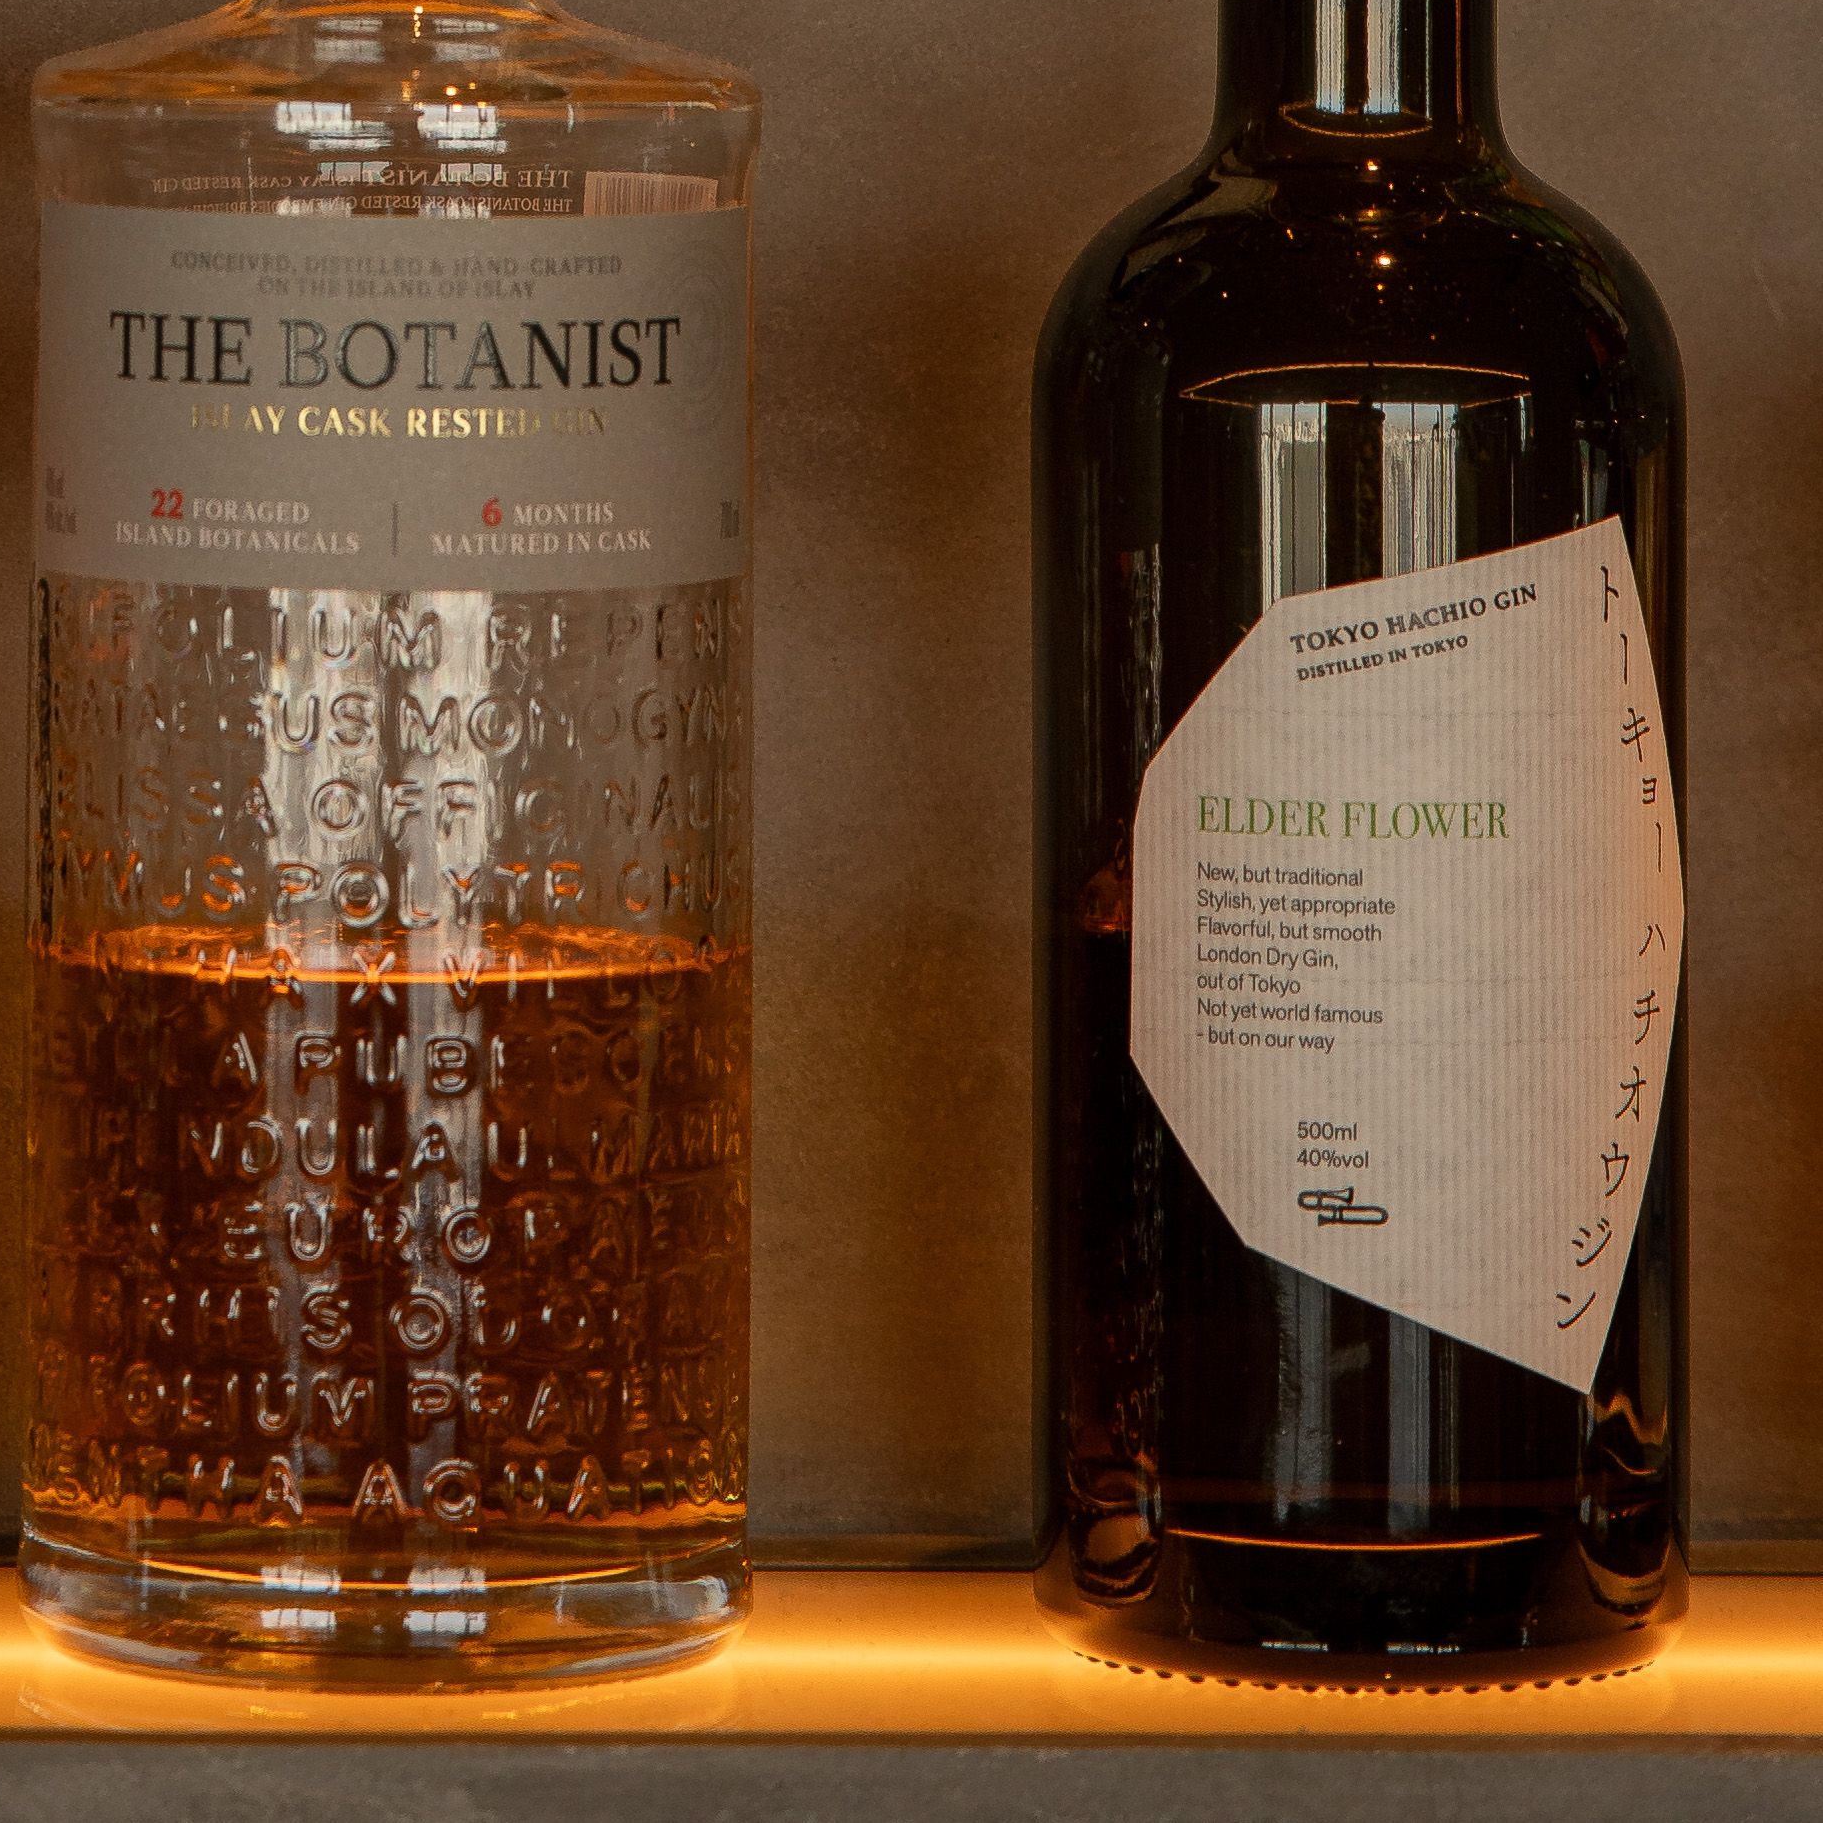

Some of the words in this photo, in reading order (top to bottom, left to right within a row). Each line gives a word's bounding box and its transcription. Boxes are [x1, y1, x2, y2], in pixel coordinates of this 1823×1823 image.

[109, 310, 253, 387] THE
[278, 317, 680, 392] BOTANIST
[297, 407, 393, 438] CASK
[407, 407, 541, 439] RESTED
[151, 489, 184, 519] 22
[193, 498, 311, 524] FORAGED
[482, 497, 503, 527] 6
[512, 503, 614, 525] MONTHS
[114, 521, 192, 548] ISLAND
[198, 527, 361, 555] BOTANICALS
[429, 533, 559, 555] MATURED
[567, 531, 592, 554] IN
[598, 529, 652, 552] CASK
[1290, 622, 1379, 654] TOKYO
[1386, 597, 1486, 636] HACHIO
[1493, 583, 1537, 611] GIN
[1296, 653, 1384, 682] DISTILLED
[1389, 647, 1407, 664] IN
[1411, 635, 1468, 659] TOKYO
[1198, 796, 1330, 837] ELDER
[1342, 802, 1509, 839] FLOWER
[1197, 862, 1239, 883] New,
[1243, 864, 1271, 884] but
[1276, 868, 1363, 886] traditional
[1197, 889, 1256, 912] Stylish,
[1259, 895, 1287, 915] yet
[1291, 897, 1396, 917] appropriate
[1197, 916, 1275, 940] Flavorful,
[1280, 922, 1308, 940] but
[1313, 924, 1382, 942] smooth
[1197, 943, 1261, 965] London
[1267, 947, 1299, 971] Dry
[1303, 950, 1339, 970] Gin,
[1197, 973, 1224, 989] out
[1228, 973, 1245, 991] of
[1248, 974, 1301, 997] Tokyo
[1197, 998, 1227, 1016] Not
[1231, 1003, 1257, 1022] yet
[1260, 1004, 1310, 1022] world
[1314, 1004, 1384, 1024] famous
[1208, 1026, 1234, 1044] but
[1238, 1030, 1261, 1047] on
[1264, 1032, 1295, 1048] our
[1298, 1035, 1335, 1054] way
[1297, 1121, 1357, 1141] 500ml
[1296, 1148, 1369, 1168] 40%vol
